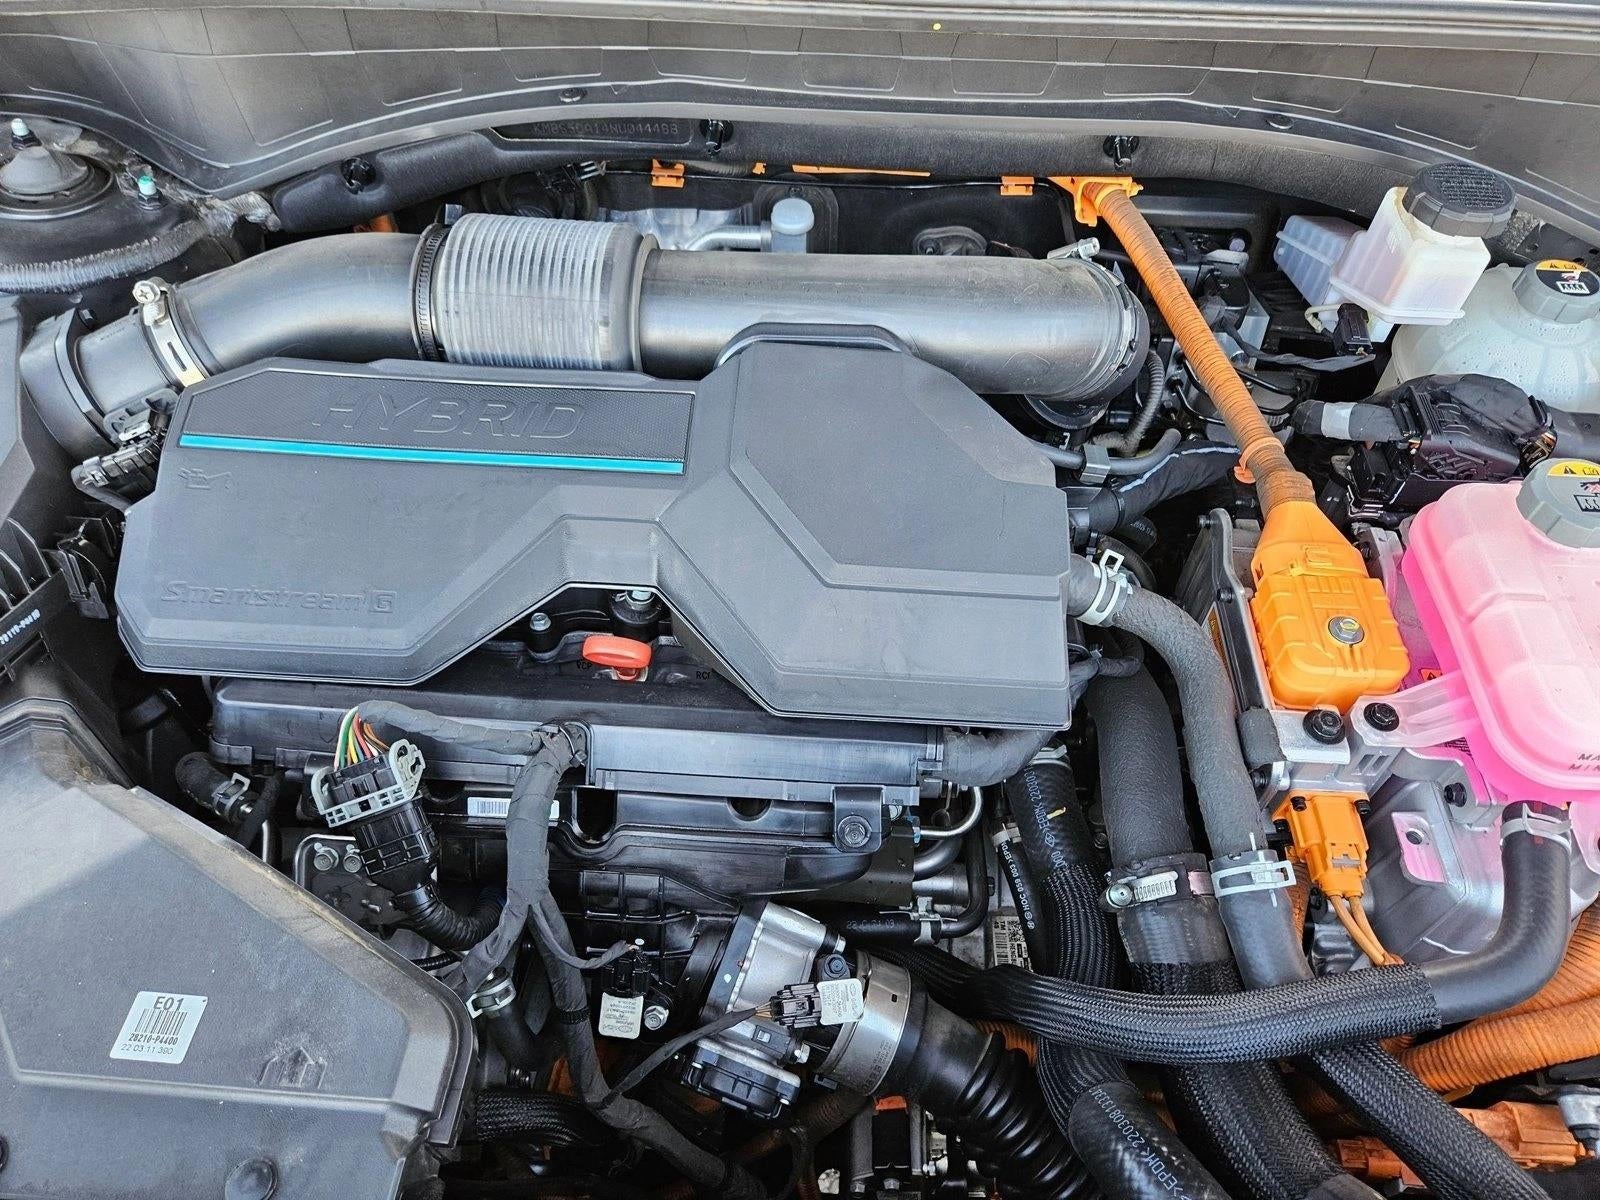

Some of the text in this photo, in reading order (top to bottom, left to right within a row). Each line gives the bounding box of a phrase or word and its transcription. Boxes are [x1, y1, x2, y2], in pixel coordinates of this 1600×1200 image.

[311, 391, 585, 439] HYBRID
[153, 996, 184, 1011] E01
[128, 1032, 179, 1046] 28210-P4400
[120, 1043, 133, 1051] 22
[133, 1044, 144, 1052] 03
[146, 1046, 156, 1054] 11
